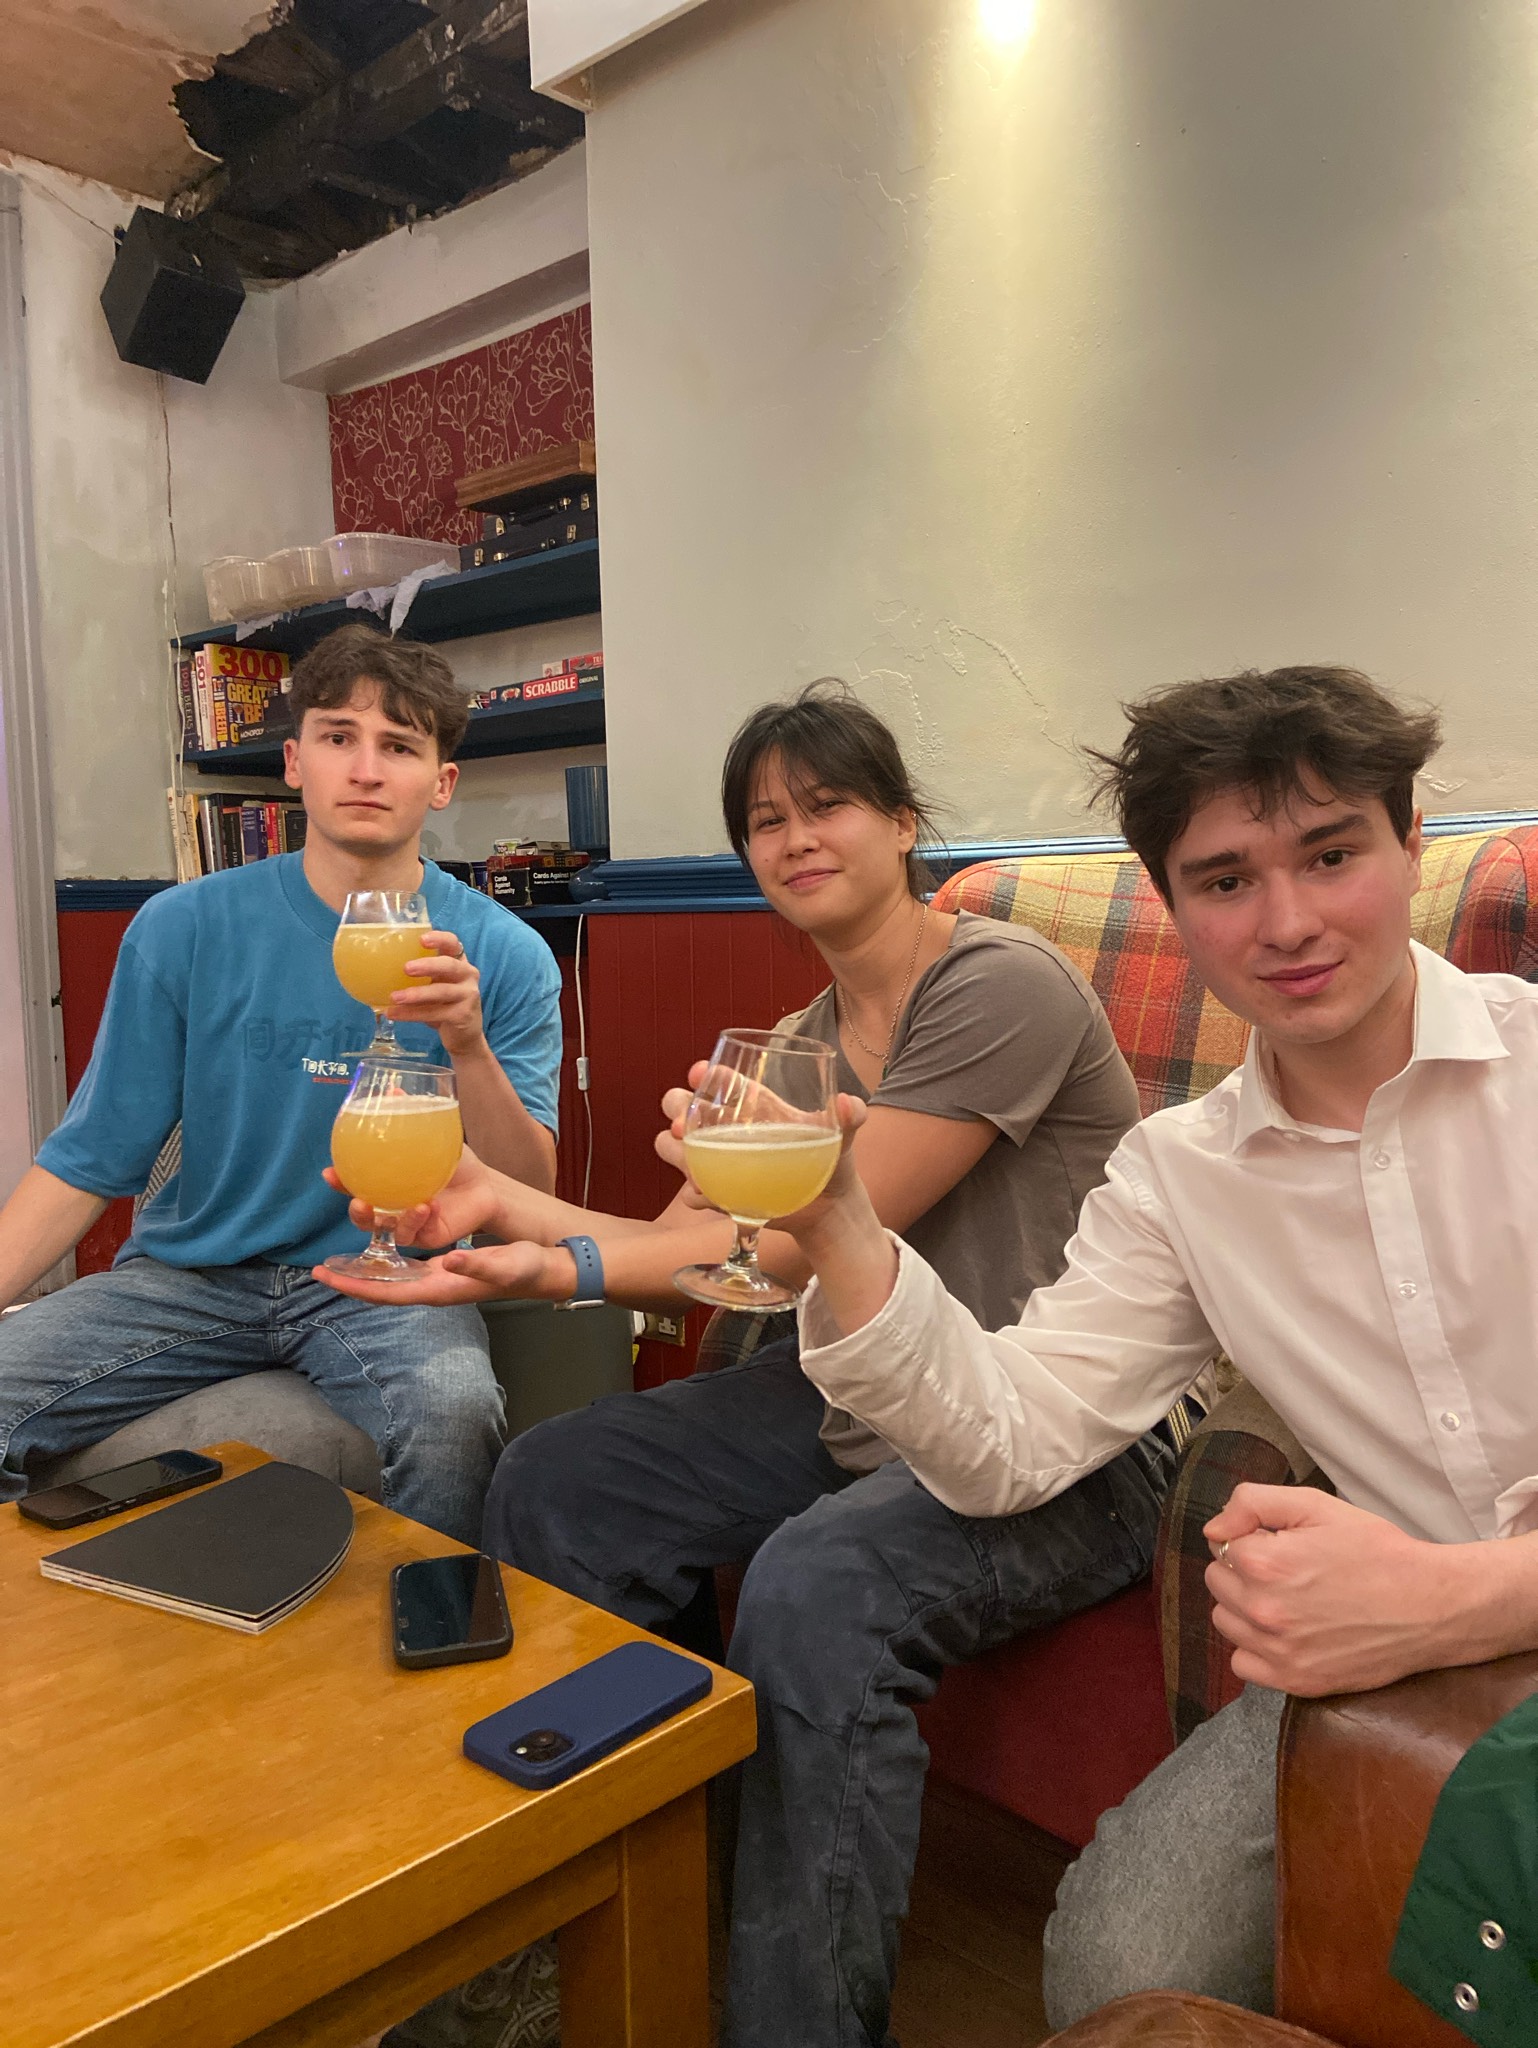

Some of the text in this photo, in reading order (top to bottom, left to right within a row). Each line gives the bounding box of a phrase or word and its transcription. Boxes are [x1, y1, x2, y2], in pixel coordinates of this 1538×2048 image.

[197, 656, 206, 690] 501
[218, 646, 283, 681] 300
[181, 667, 190, 693] 1001
[525, 676, 577, 698] SCRABBLE
[579, 674, 599, 684] ORIGINAL
[227, 683, 265, 704] GREAT
[184, 695, 194, 730] BEERS
[216, 708, 228, 735] BEER
[240, 727, 265, 739] MONOPOLY
[495, 881, 511, 889] Against
[550, 872, 570, 880] Against
[495, 887, 516, 895] Humanity
